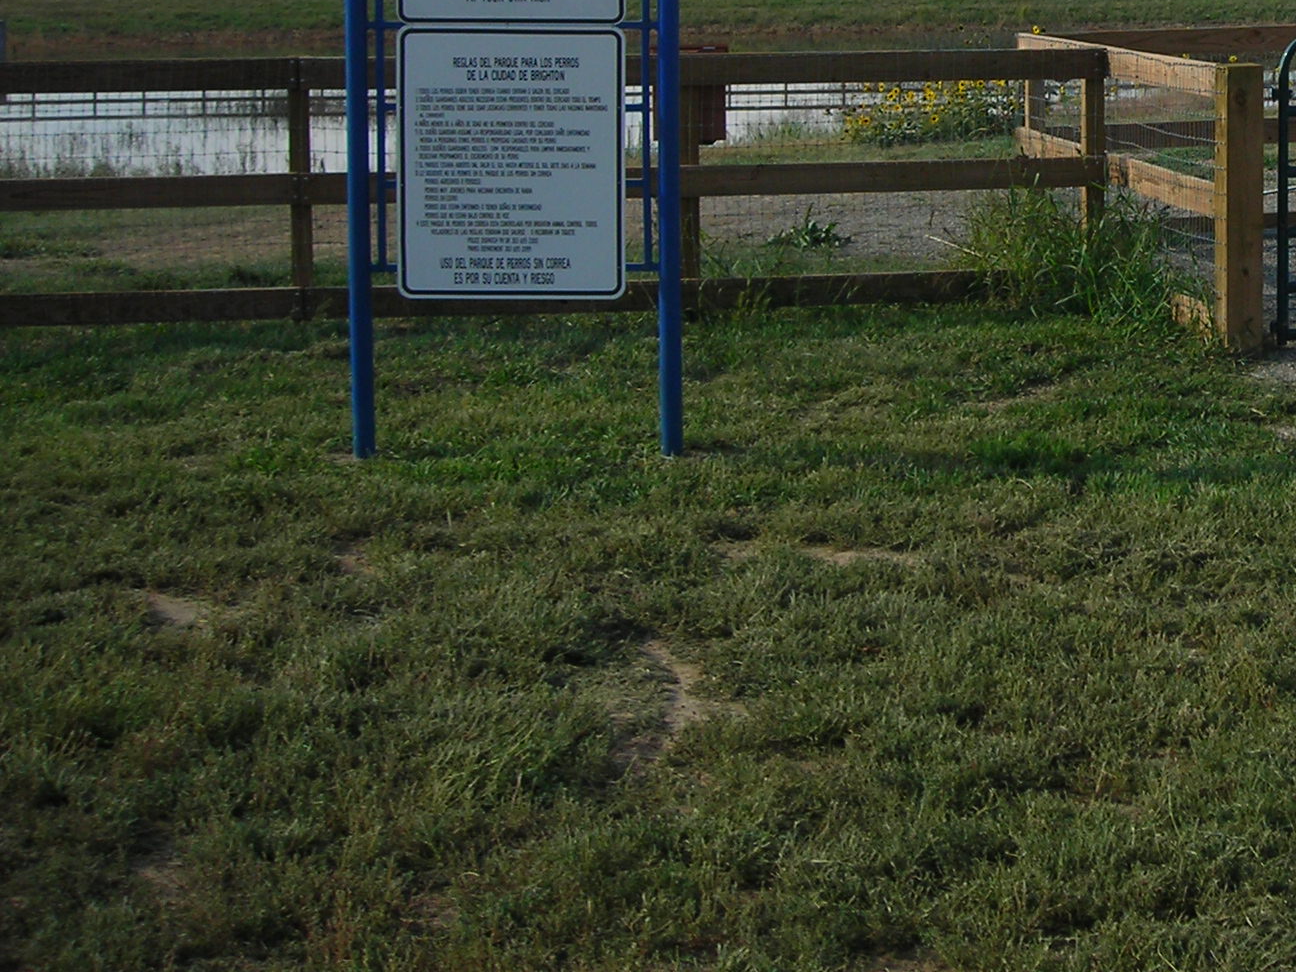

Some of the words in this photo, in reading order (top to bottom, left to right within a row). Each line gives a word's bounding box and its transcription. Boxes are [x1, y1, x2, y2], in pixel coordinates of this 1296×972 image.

[453, 57, 478, 68] REGLAS
[479, 57, 492, 68] DEL
[494, 57, 518, 68] PARQUE
[521, 57, 538, 68] PARA
[540, 57, 552, 68] LOS
[555, 57, 579, 68] PERROS
[467, 70, 476, 81] DE
[479, 70, 489, 81] LA
[491, 70, 516, 81] CIUDAD
[519, 70, 528, 81] DE
[531, 70, 565, 81] BRIGHTON
[440, 257, 453, 269] USO
[455, 257, 467, 269] DEL
[469, 257, 494, 269] PARQUE
[496, 257, 505, 269] DE
[507, 258, 531, 269] PERROS
[533, 258, 544, 269] SIN
[546, 258, 571, 269] CORREA
[454, 272, 463, 284] ES
[465, 272, 480, 284] POR
[482, 273, 492, 284] SU
[494, 272, 520, 284] CUENTA
[522, 273, 528, 284] Y
[530, 273, 555, 284] RIESGO
